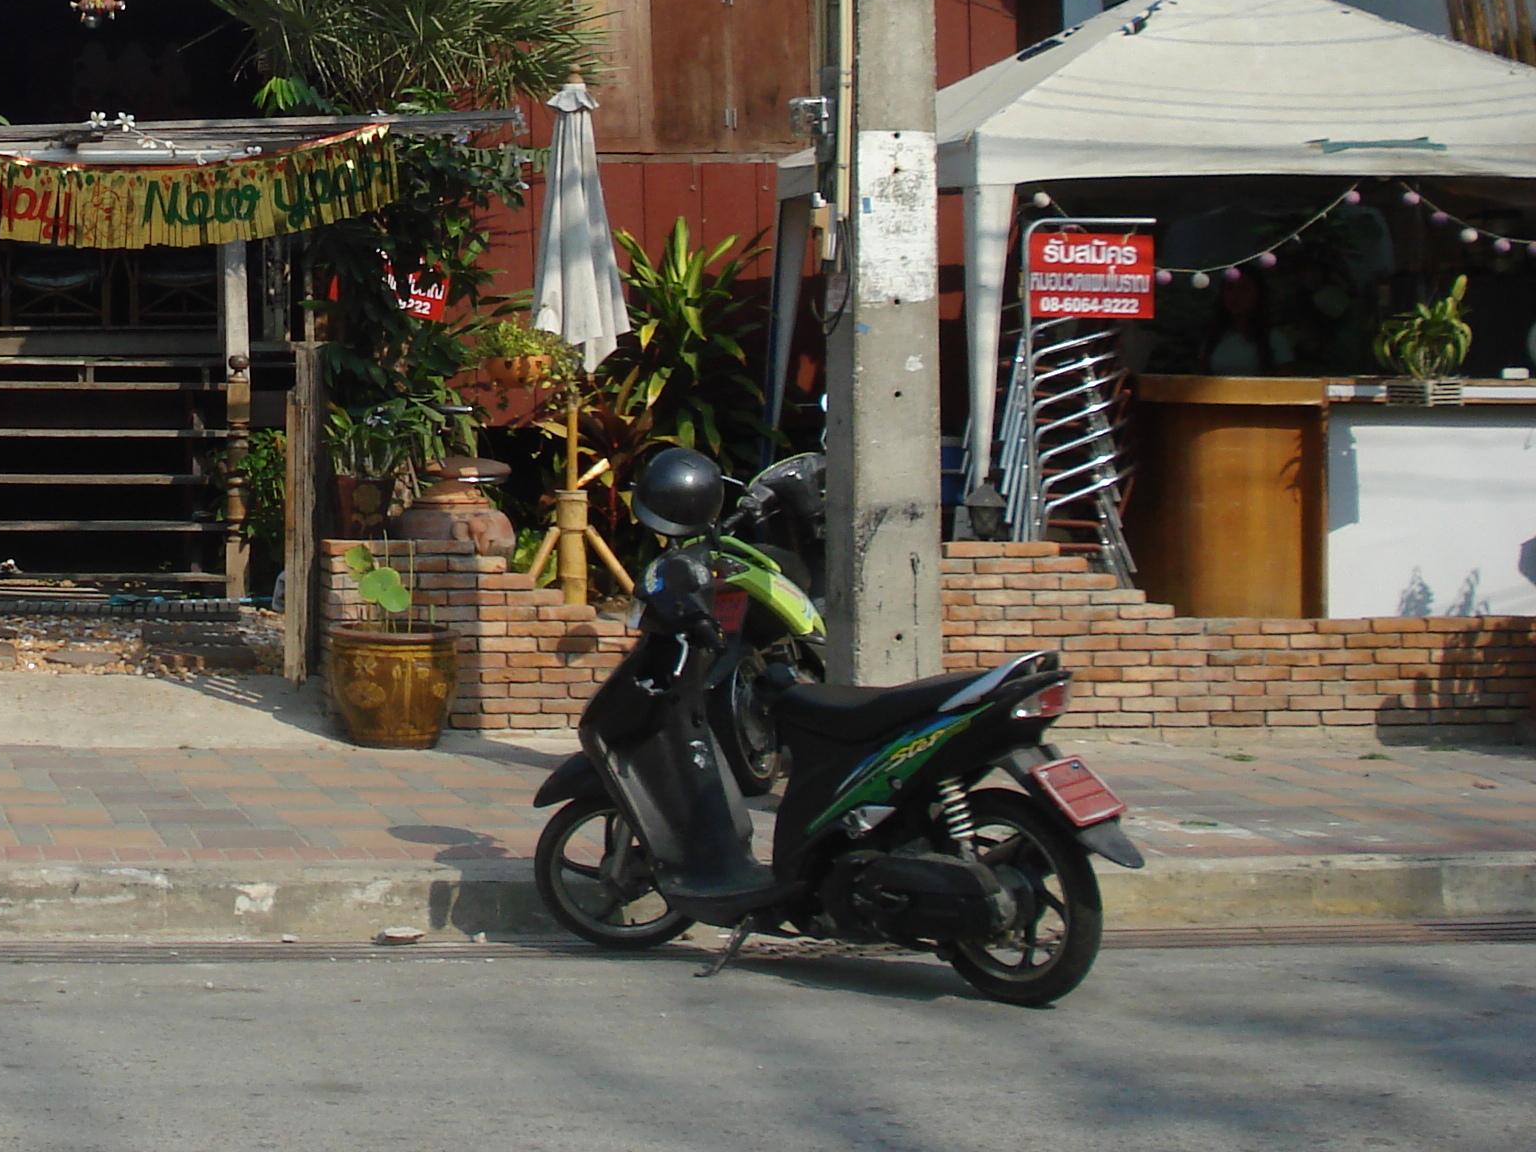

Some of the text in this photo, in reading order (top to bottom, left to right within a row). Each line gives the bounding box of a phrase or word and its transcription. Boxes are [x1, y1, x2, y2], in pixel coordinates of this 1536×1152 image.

[143, 179, 262, 226] New
[1042, 238, 1139, 265] รับสมัคร
[1039, 296, 1141, 314] 08-6064-9222
